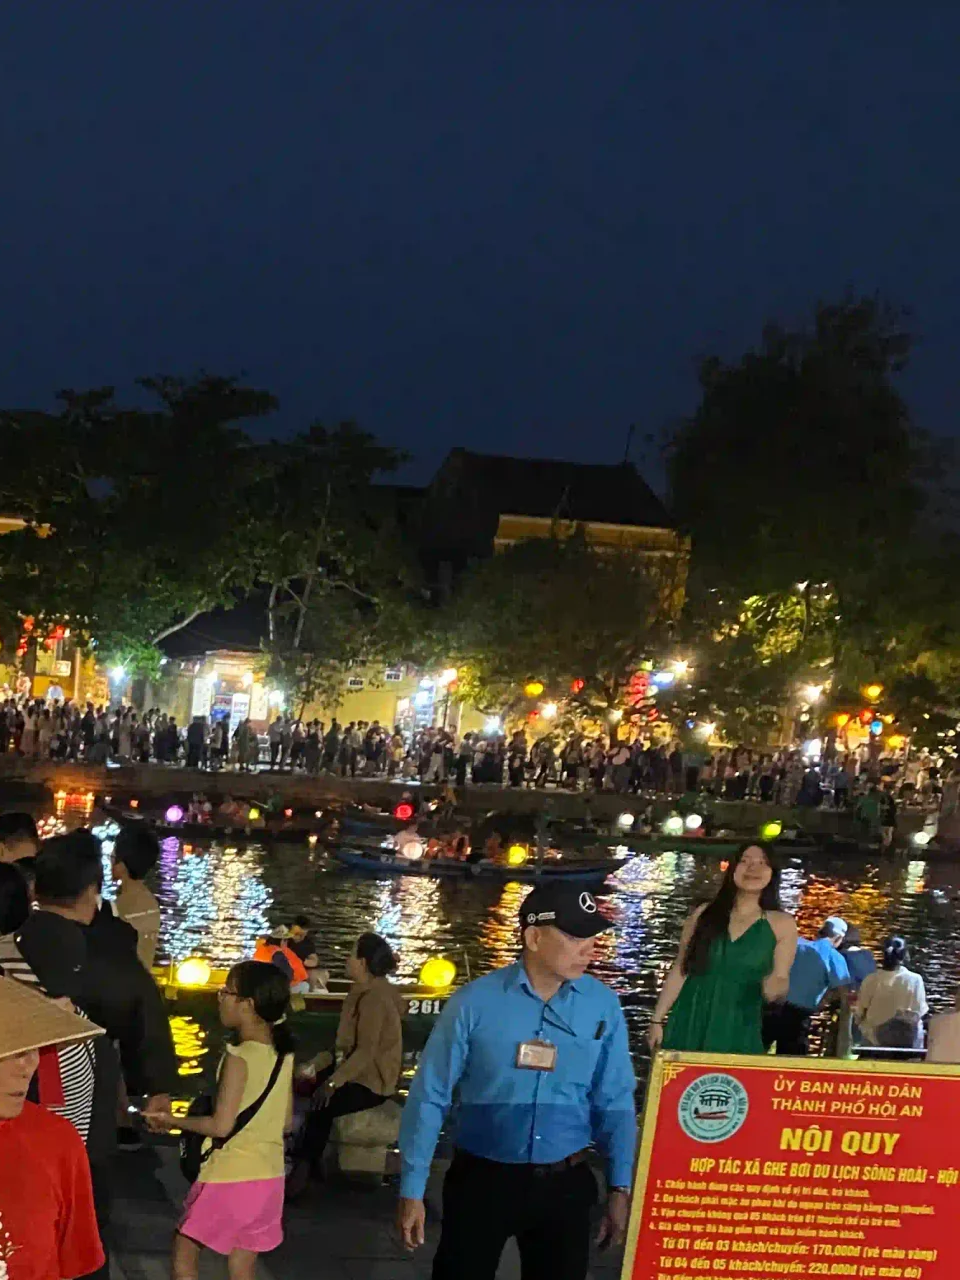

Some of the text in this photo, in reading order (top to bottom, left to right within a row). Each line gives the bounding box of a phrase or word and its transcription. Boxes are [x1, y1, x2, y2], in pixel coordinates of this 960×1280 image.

[773, 1075, 922, 1098] ỦY BAN NHÂN DÂN
[770, 1095, 923, 1117] THÀNH PHỐ HỘI AN
[779, 1123, 899, 1157] NỘI QUY
[689, 1156, 715, 1175] HỢP
[717, 1156, 741, 1174] TÁC
[743, 1157, 761, 1175] XÃ
[762, 1161, 787, 1176] GHE
[789, 1161, 811, 1177] BƠI
[812, 1163, 830, 1178] DU
[831, 1164, 860, 1182] LỊCH
[861, 1163, 896, 1181] SÔNG
